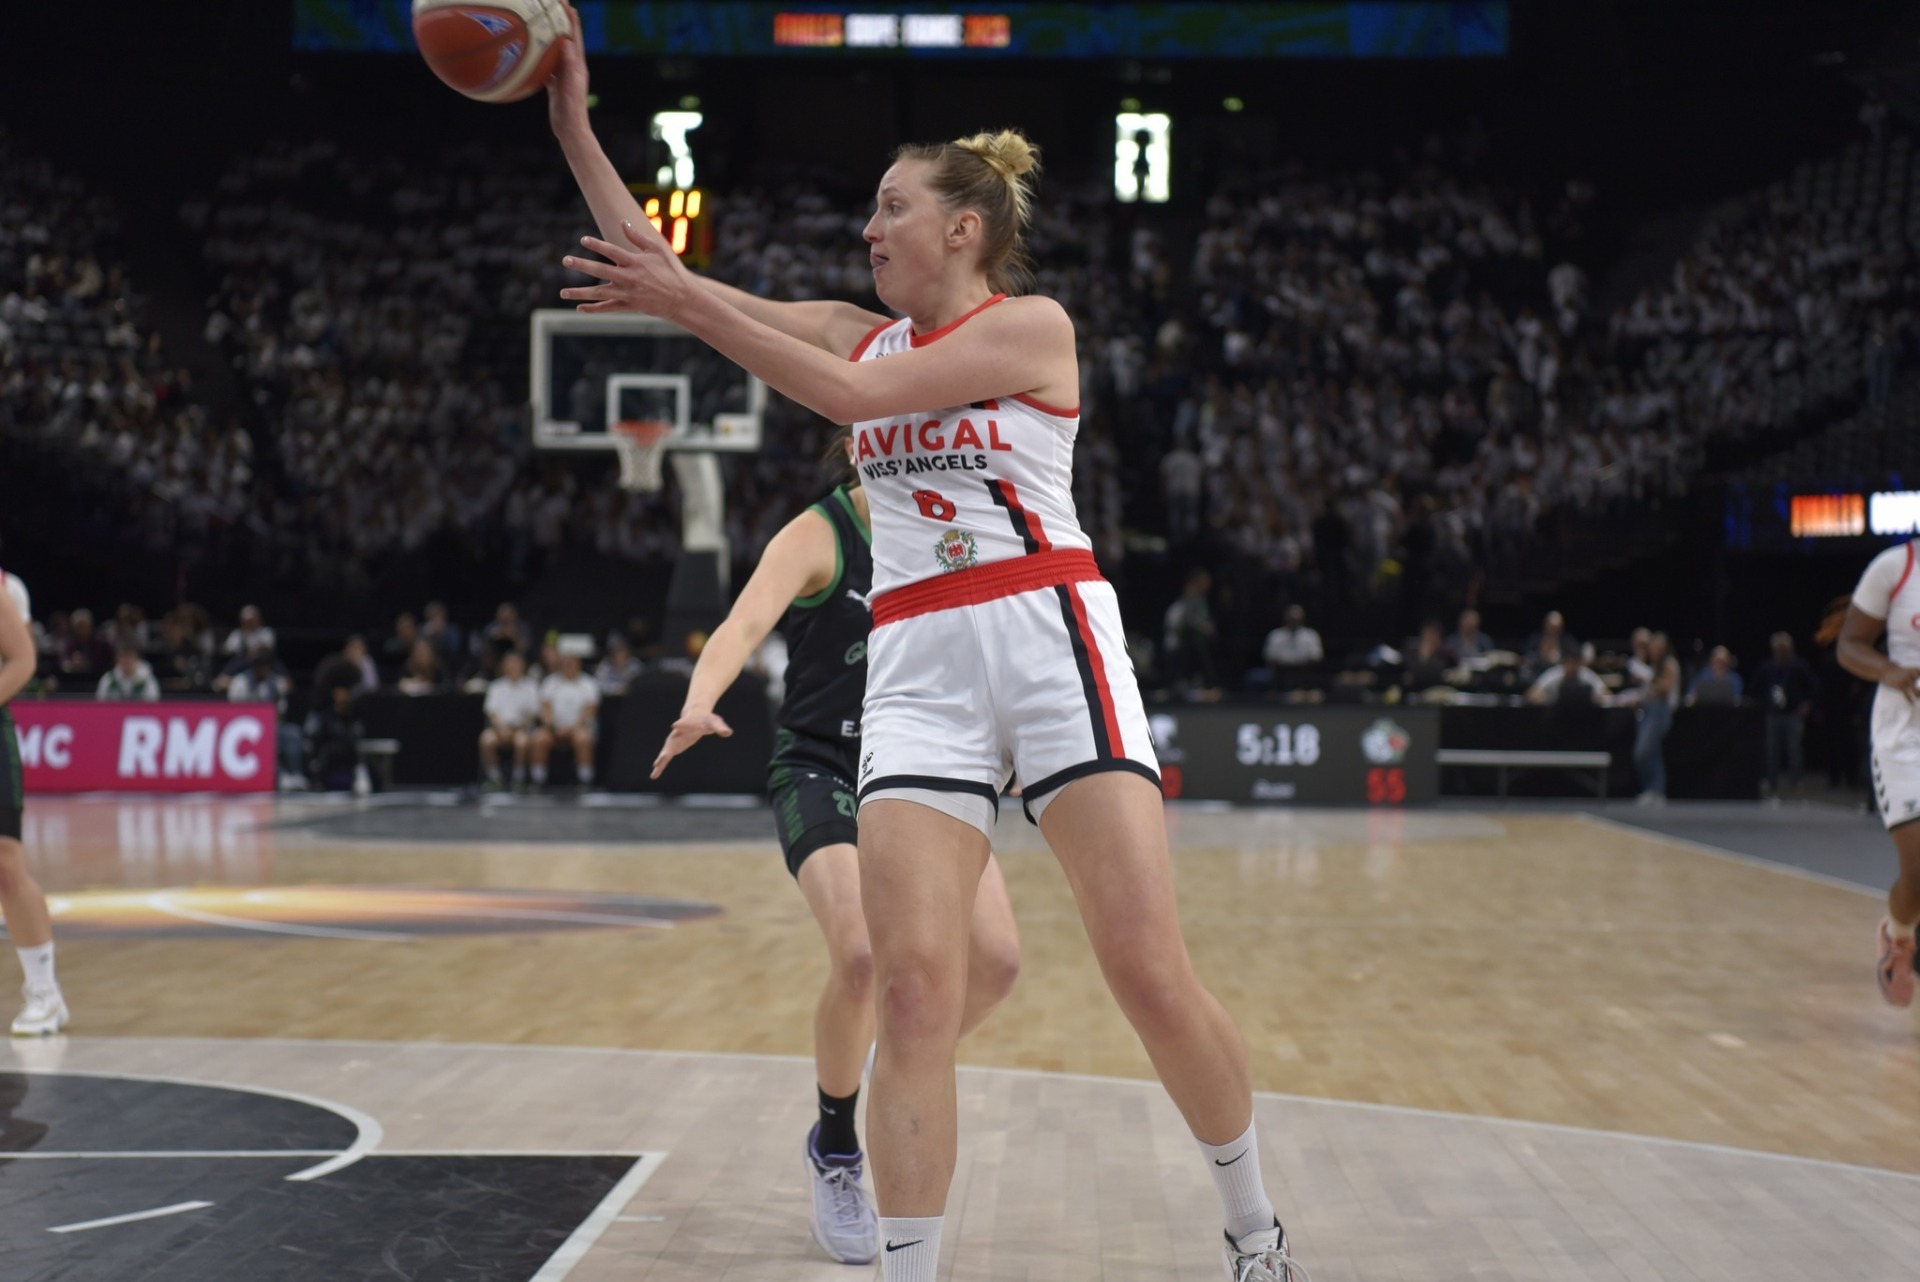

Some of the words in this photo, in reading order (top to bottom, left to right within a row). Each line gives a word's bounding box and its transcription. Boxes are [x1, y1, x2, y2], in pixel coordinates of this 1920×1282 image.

[854, 418, 1012, 465] AVIGAL
[15, 725, 74, 769] MC
[117, 716, 263, 780] RMC
